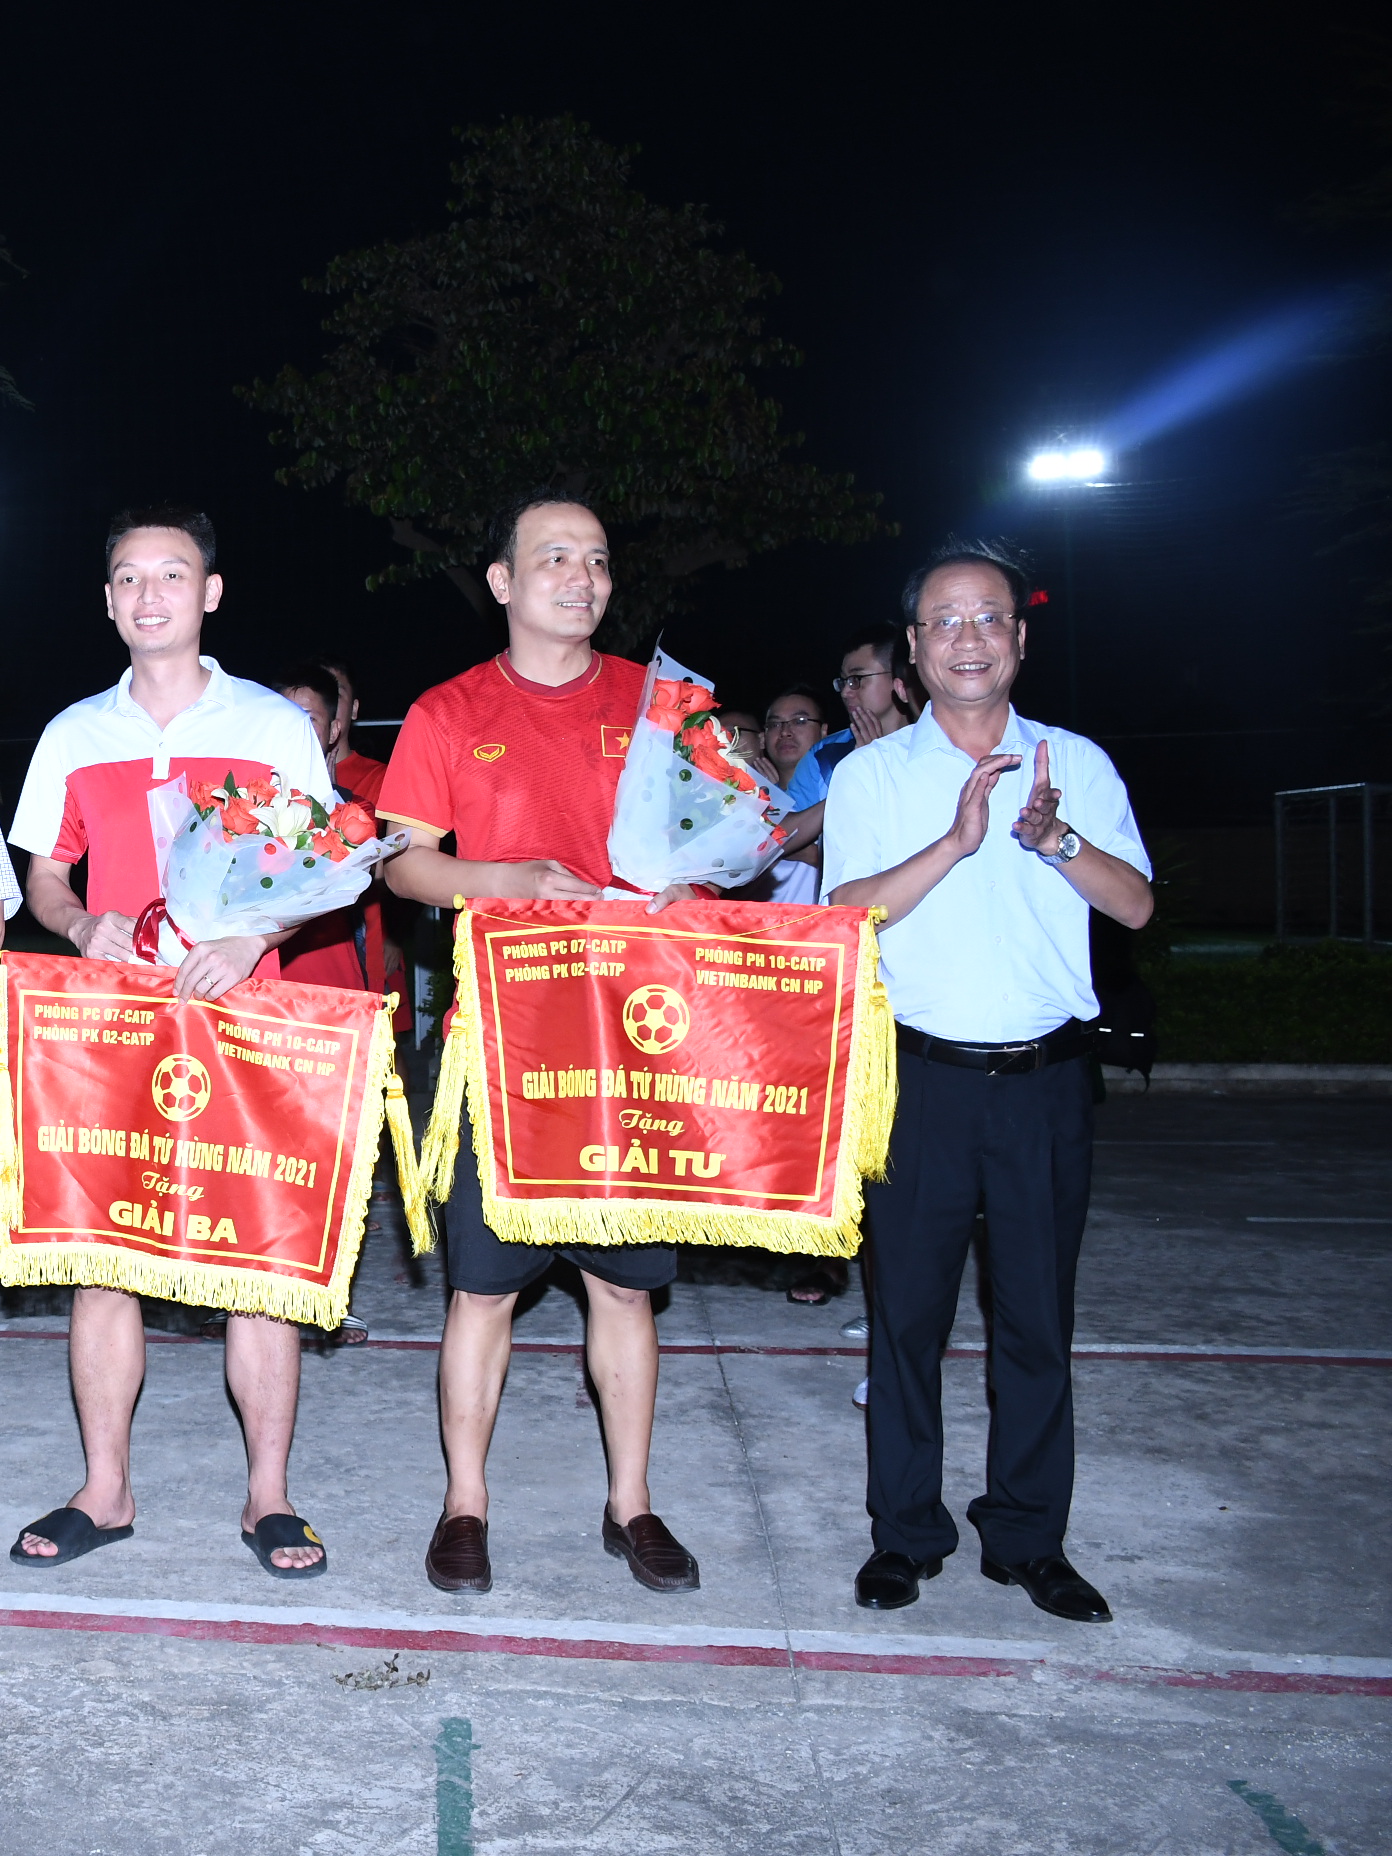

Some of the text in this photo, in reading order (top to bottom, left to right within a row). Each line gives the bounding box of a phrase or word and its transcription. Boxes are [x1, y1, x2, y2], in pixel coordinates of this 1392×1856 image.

[502, 939, 627, 960] PHÒNG PC 07-CATP
[695, 946, 826, 972] PHÒNG PH 10-CATP
[505, 962, 626, 982] PHÒNG PK 02-CATP
[696, 969, 824, 995] VIETINBANK CN HP
[34, 1002, 155, 1025] PHÒNG PC 07-CATP
[33, 1024, 155, 1046] PHÒNG PK 02-CATP
[217, 1019, 341, 1056] PHÒNG PH 10-CATP
[217, 1041, 336, 1078] VIETINBANK CN HP
[521, 1063, 808, 1115] GIẢI BÓNG ĐÁ TỨ HÙNG NĂM 2021
[618, 1108, 685, 1137] Tặng
[37, 1119, 317, 1189] GIẢI BÓNG ĐÁ TỨ HÙNG NĂM 2021
[579, 1138, 727, 1179] GIẢI TƯ
[141, 1171, 205, 1201] Tặng
[108, 1200, 238, 1244] GIẢI BA
